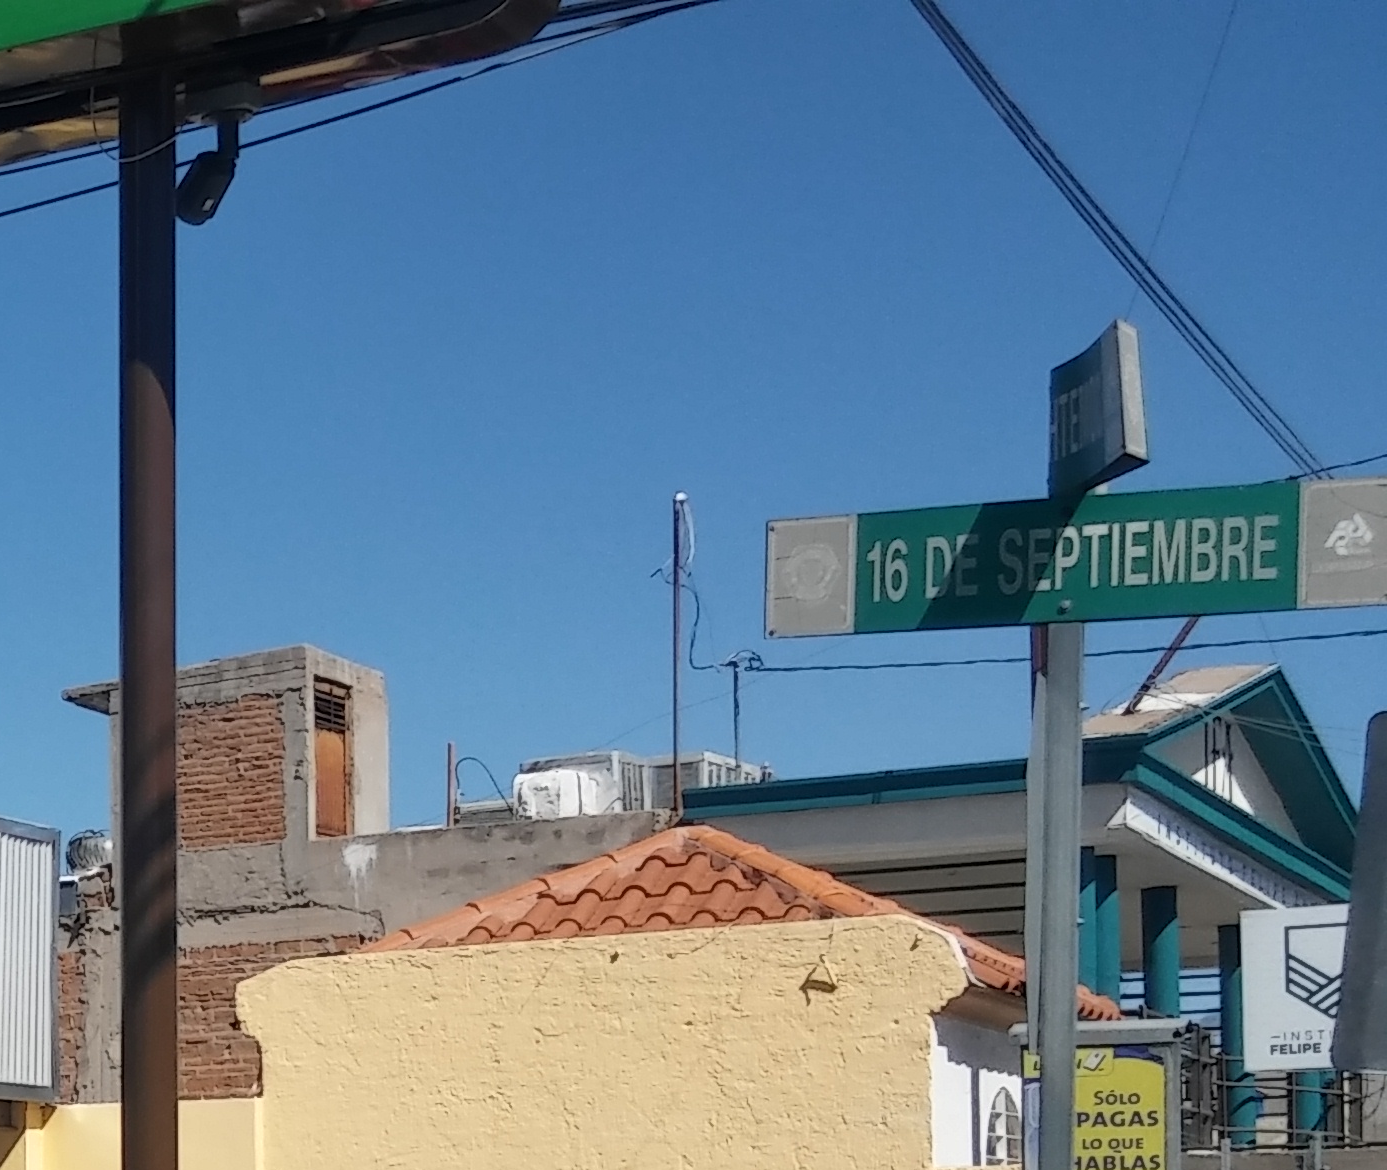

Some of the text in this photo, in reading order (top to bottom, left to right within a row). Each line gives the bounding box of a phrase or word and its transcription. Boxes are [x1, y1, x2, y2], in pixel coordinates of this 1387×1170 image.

[866, 514, 1280, 603] 16 DE SEPTIEMBRE
[1270, 1043, 1322, 1056] FELIPE
[1093, 1090, 1141, 1106] SÓLO
[1076, 1110, 1159, 1128] PAGAS
[1082, 1138, 1144, 1153] LO QUE
